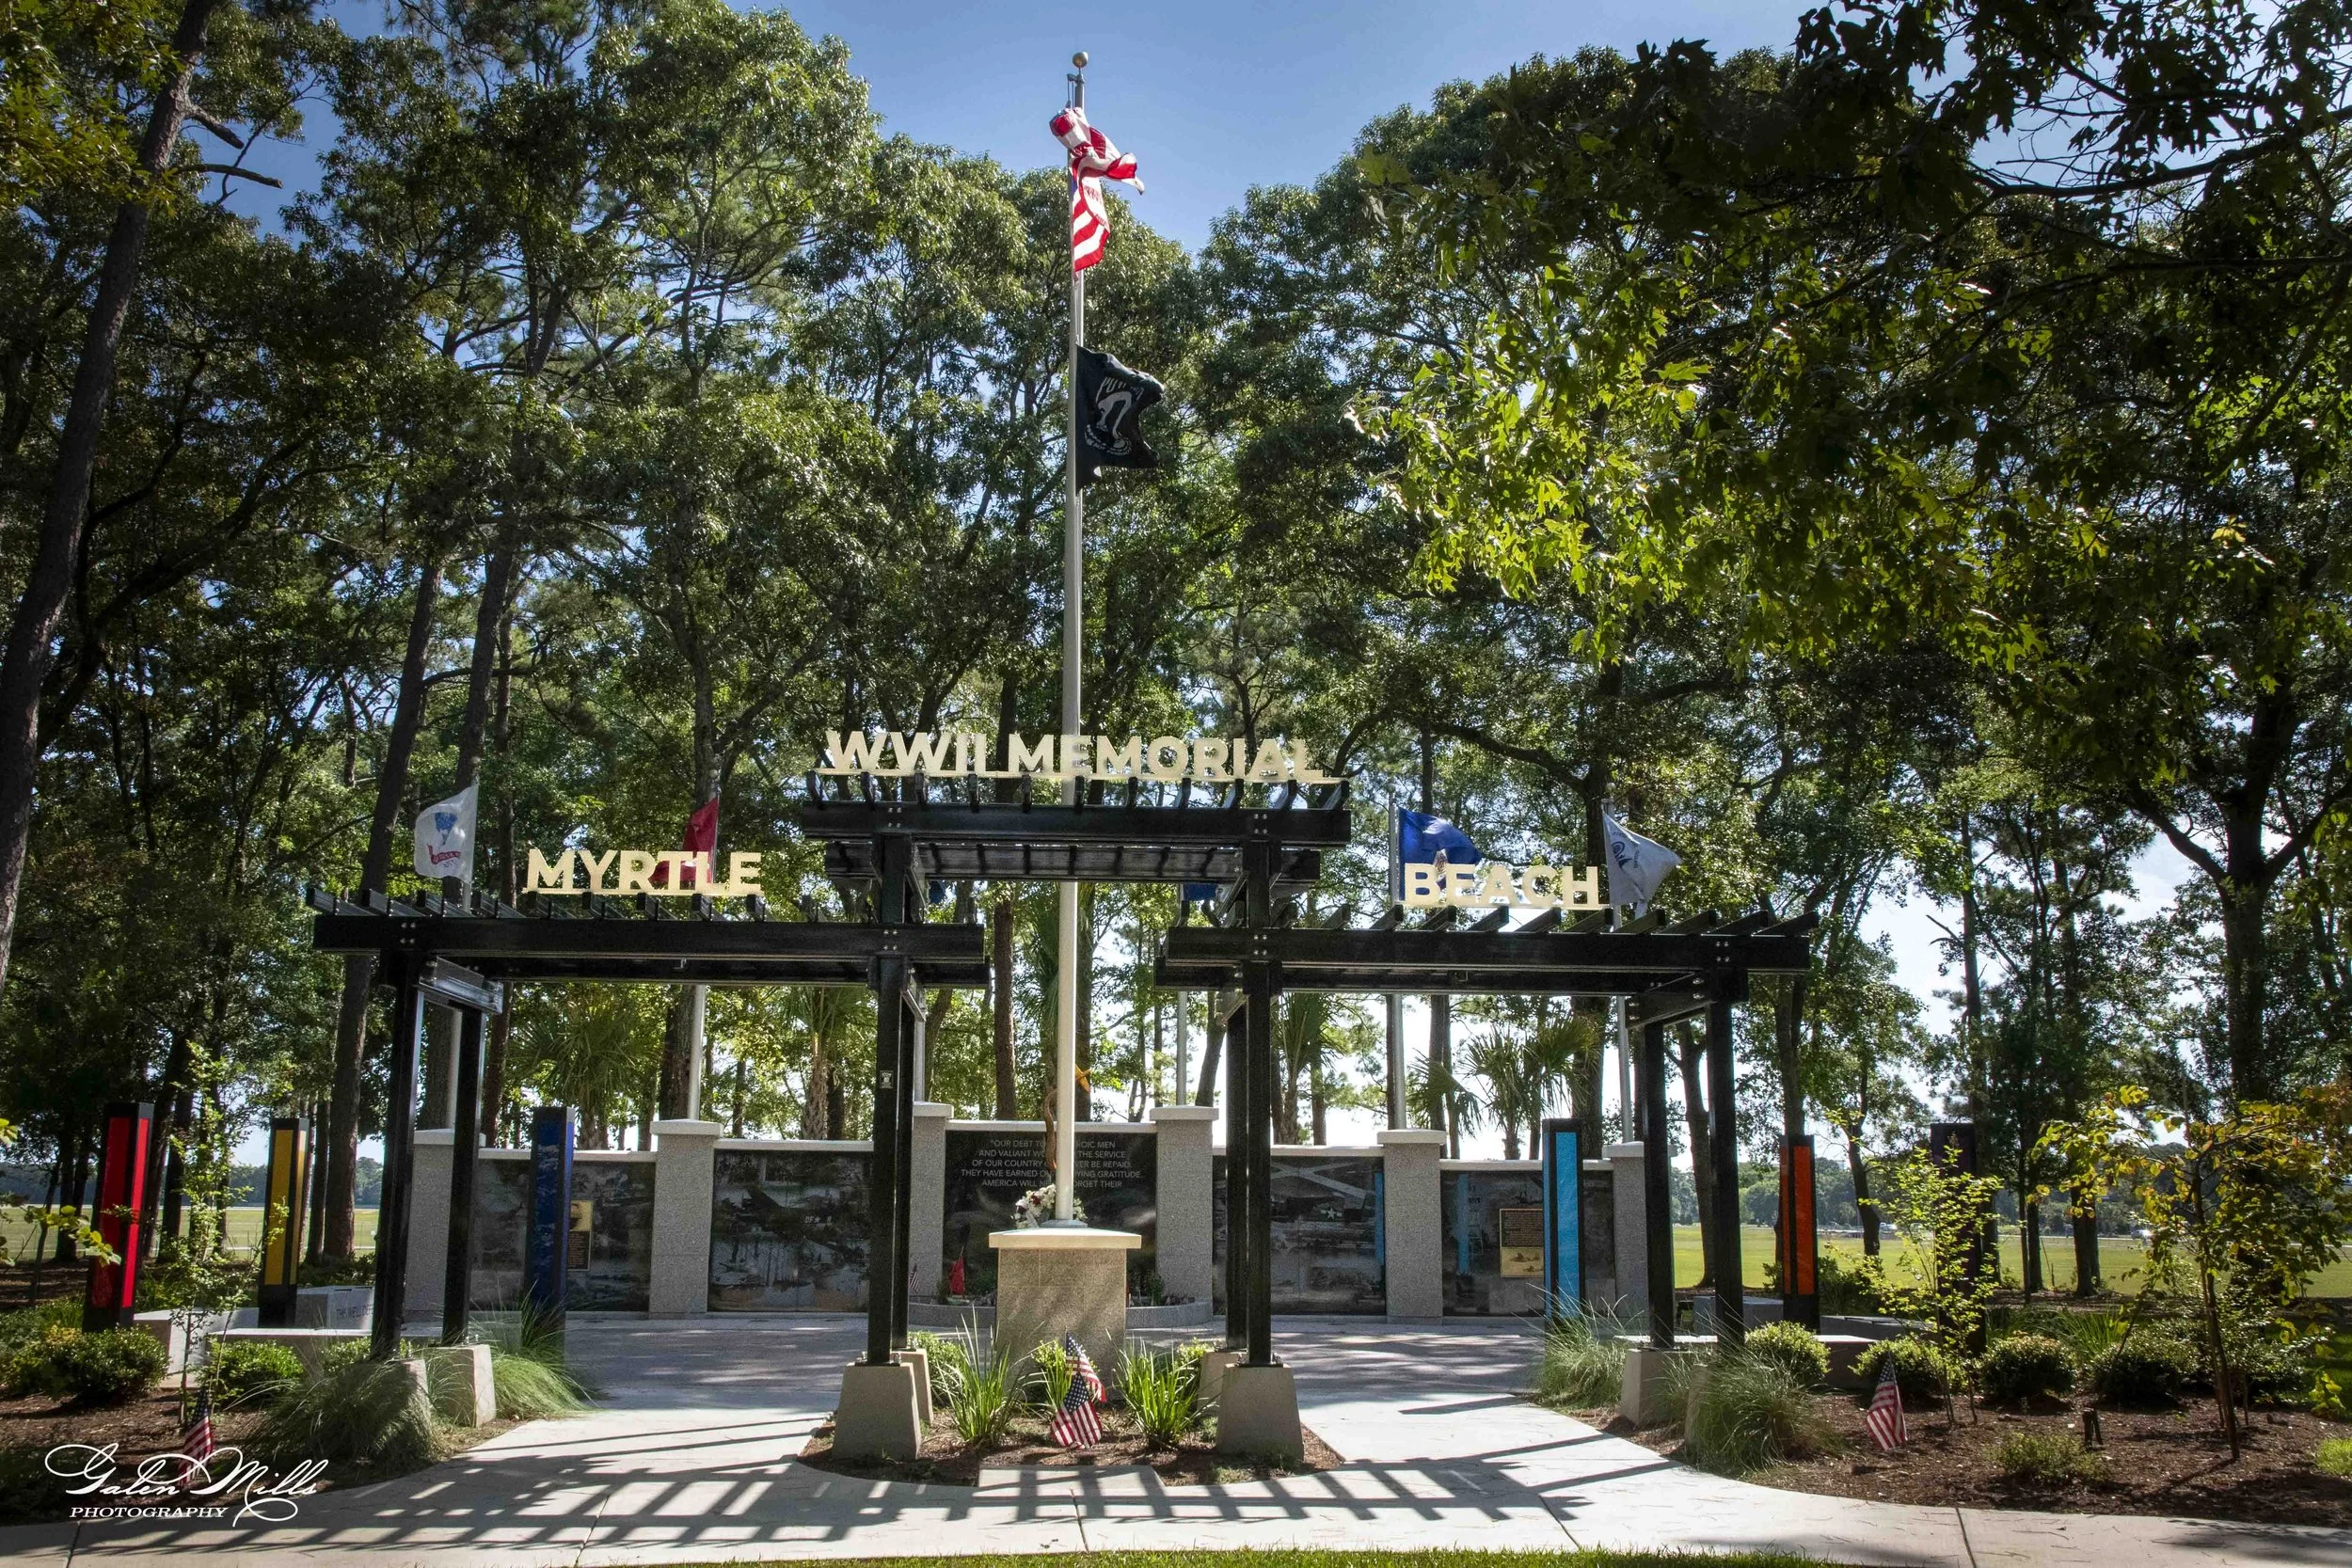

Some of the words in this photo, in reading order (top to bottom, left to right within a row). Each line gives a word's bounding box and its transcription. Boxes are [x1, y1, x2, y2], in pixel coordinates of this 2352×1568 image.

[825, 731, 986, 774] WWII
[1008, 734, 1324, 781] MEMORIAL
[527, 848, 762, 892] MYRTLE
[1404, 863, 1599, 906] BEACH
[998, 1149, 1031, 1158] VALIANT
[1079, 1150, 1093, 1159] THE
[1095, 1150, 1126, 1159] SERVICE
[972, 1159, 984, 1167] OF
[985, 1159, 1003, 1167] OUR
[1004, 1160, 1042, 1168] COUNTRY
[1075, 1160, 1089, 1168] VER
[1090, 1160, 1102, 1168] BE
[961, 1168, 981, 1178] THEY
[983, 1168, 1005, 1178] HAVE
[1006, 1169, 1039, 1178] EARNED
[1076, 1170, 1095, 1179] YING
[981, 1179, 1018, 1188] AMERICA
[1019, 1180, 1037, 1188] WILL
[1100, 1180, 1123, 1189] THEIR
